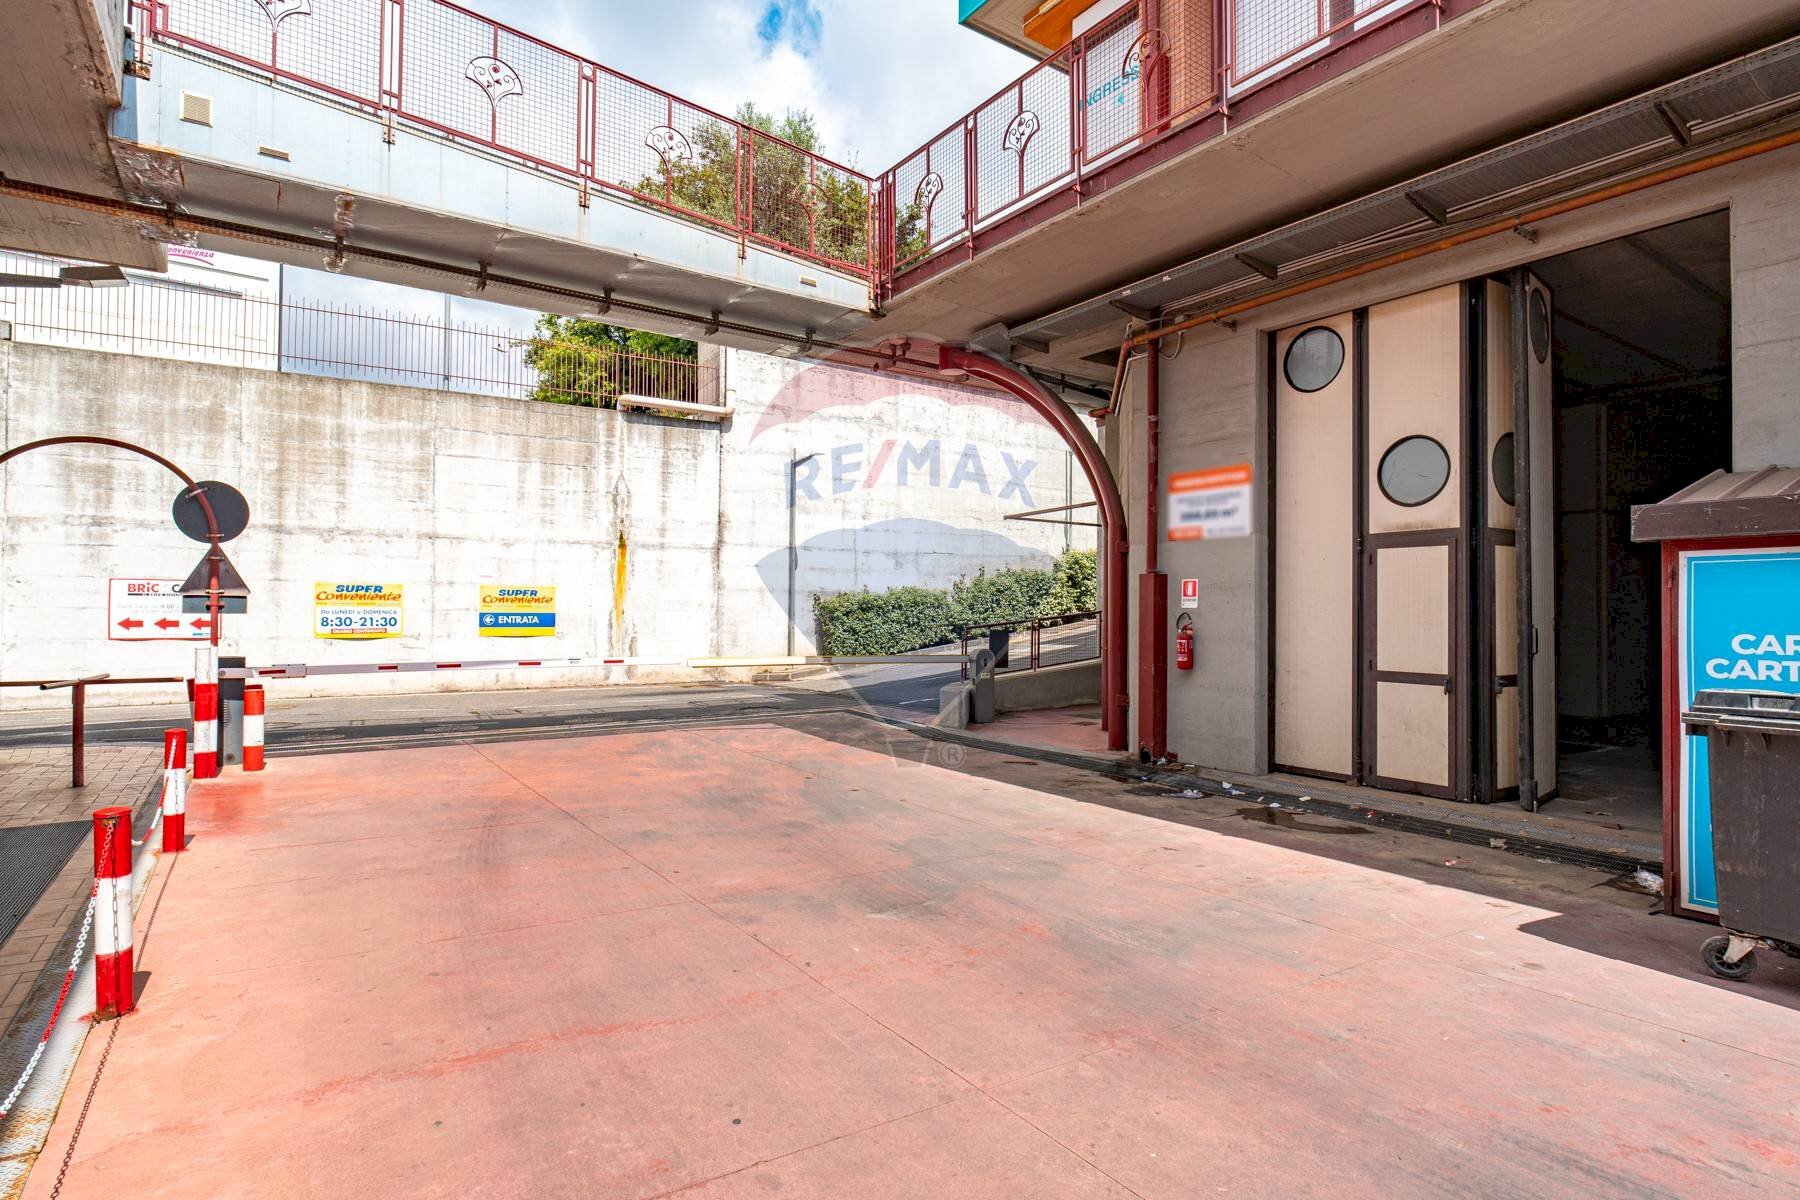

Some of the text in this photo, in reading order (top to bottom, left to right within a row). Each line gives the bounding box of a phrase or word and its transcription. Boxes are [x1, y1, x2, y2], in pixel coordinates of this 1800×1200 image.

[168, 246, 215, 258] onvenienza
[336, 584, 383, 593] SUPER
[498, 589, 538, 597] SUPER
[316, 591, 402, 601] Conveniente
[482, 594, 553, 604] Conveniente
[320, 616, 398, 627] 8:30-21:30
[498, 615, 540, 624] ENTRATA
[1705, 658, 1800, 682] CART
